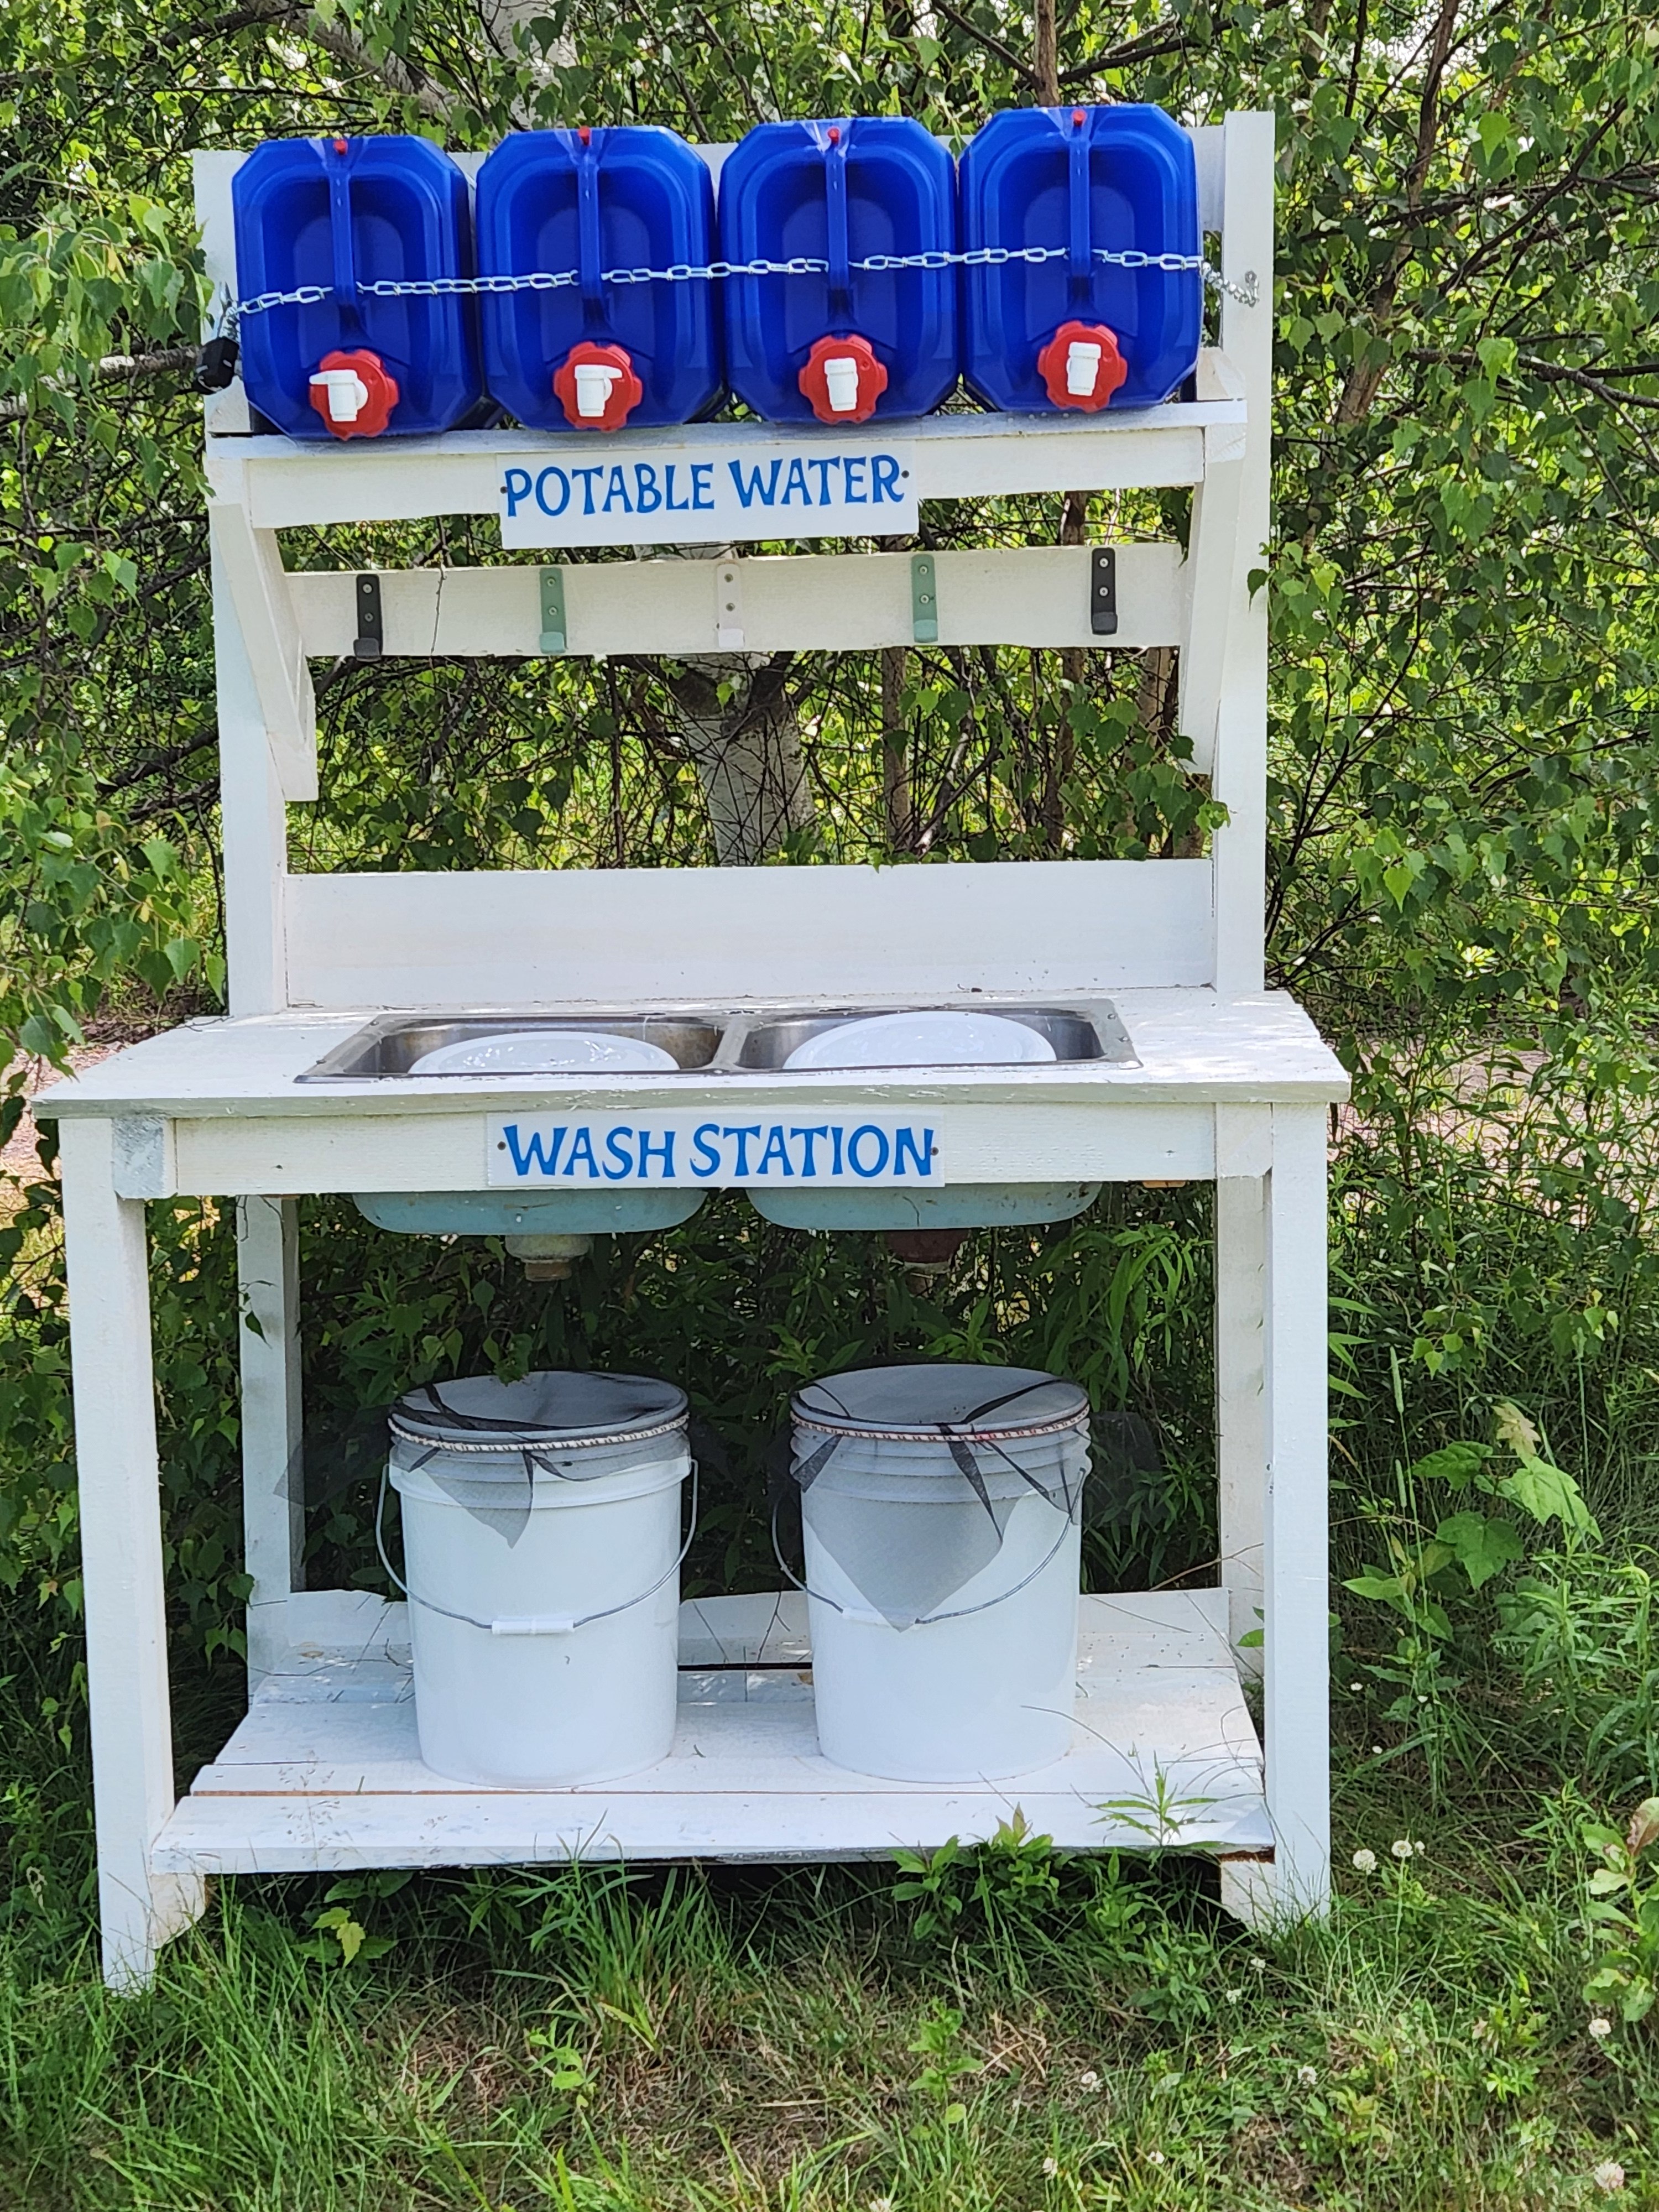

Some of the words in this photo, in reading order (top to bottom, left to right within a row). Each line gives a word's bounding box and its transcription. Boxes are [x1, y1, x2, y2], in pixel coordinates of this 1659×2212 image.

[504, 462, 715, 518] POTABLE
[727, 454, 905, 509] WATER
[502, 1124, 676, 1181] WASH
[689, 1123, 935, 1178] STATION
